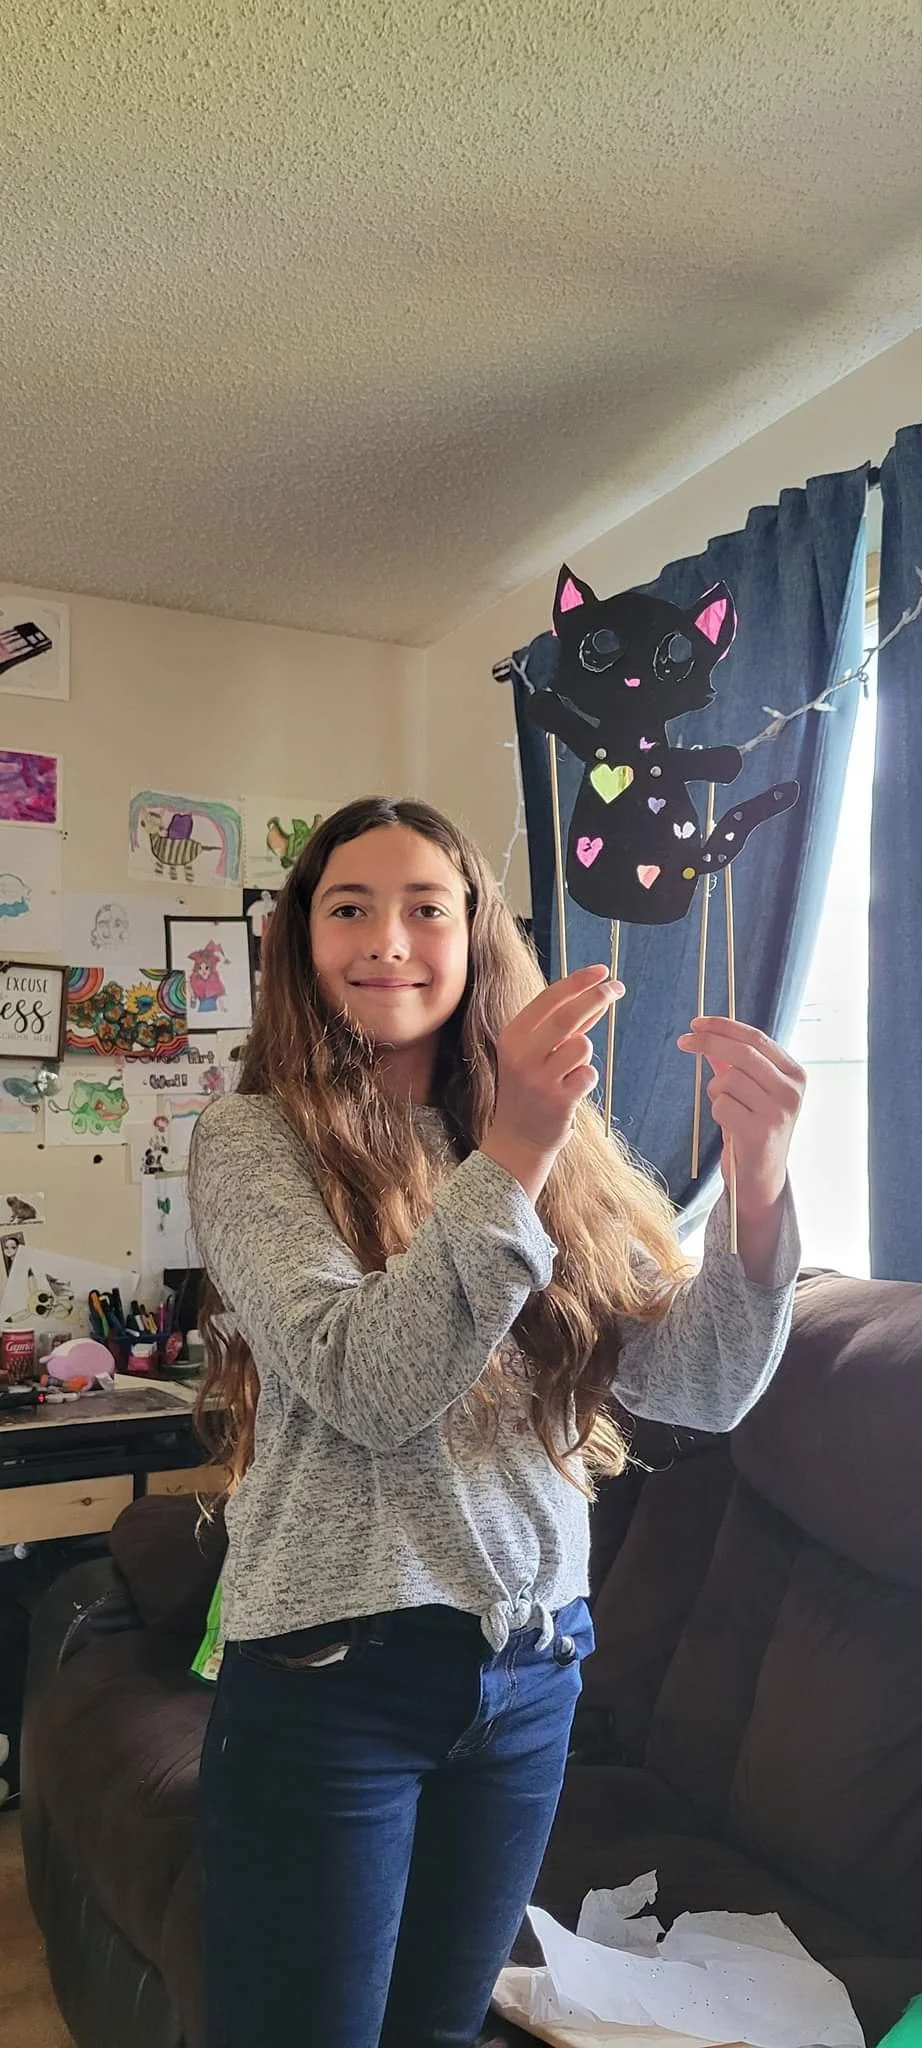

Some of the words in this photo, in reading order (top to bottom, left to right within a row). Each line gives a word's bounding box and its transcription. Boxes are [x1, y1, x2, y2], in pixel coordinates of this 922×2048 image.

[6, 976, 48, 993] EXCUSE
[0, 999, 52, 1034] ess
[187, 1047, 215, 1064] Art
